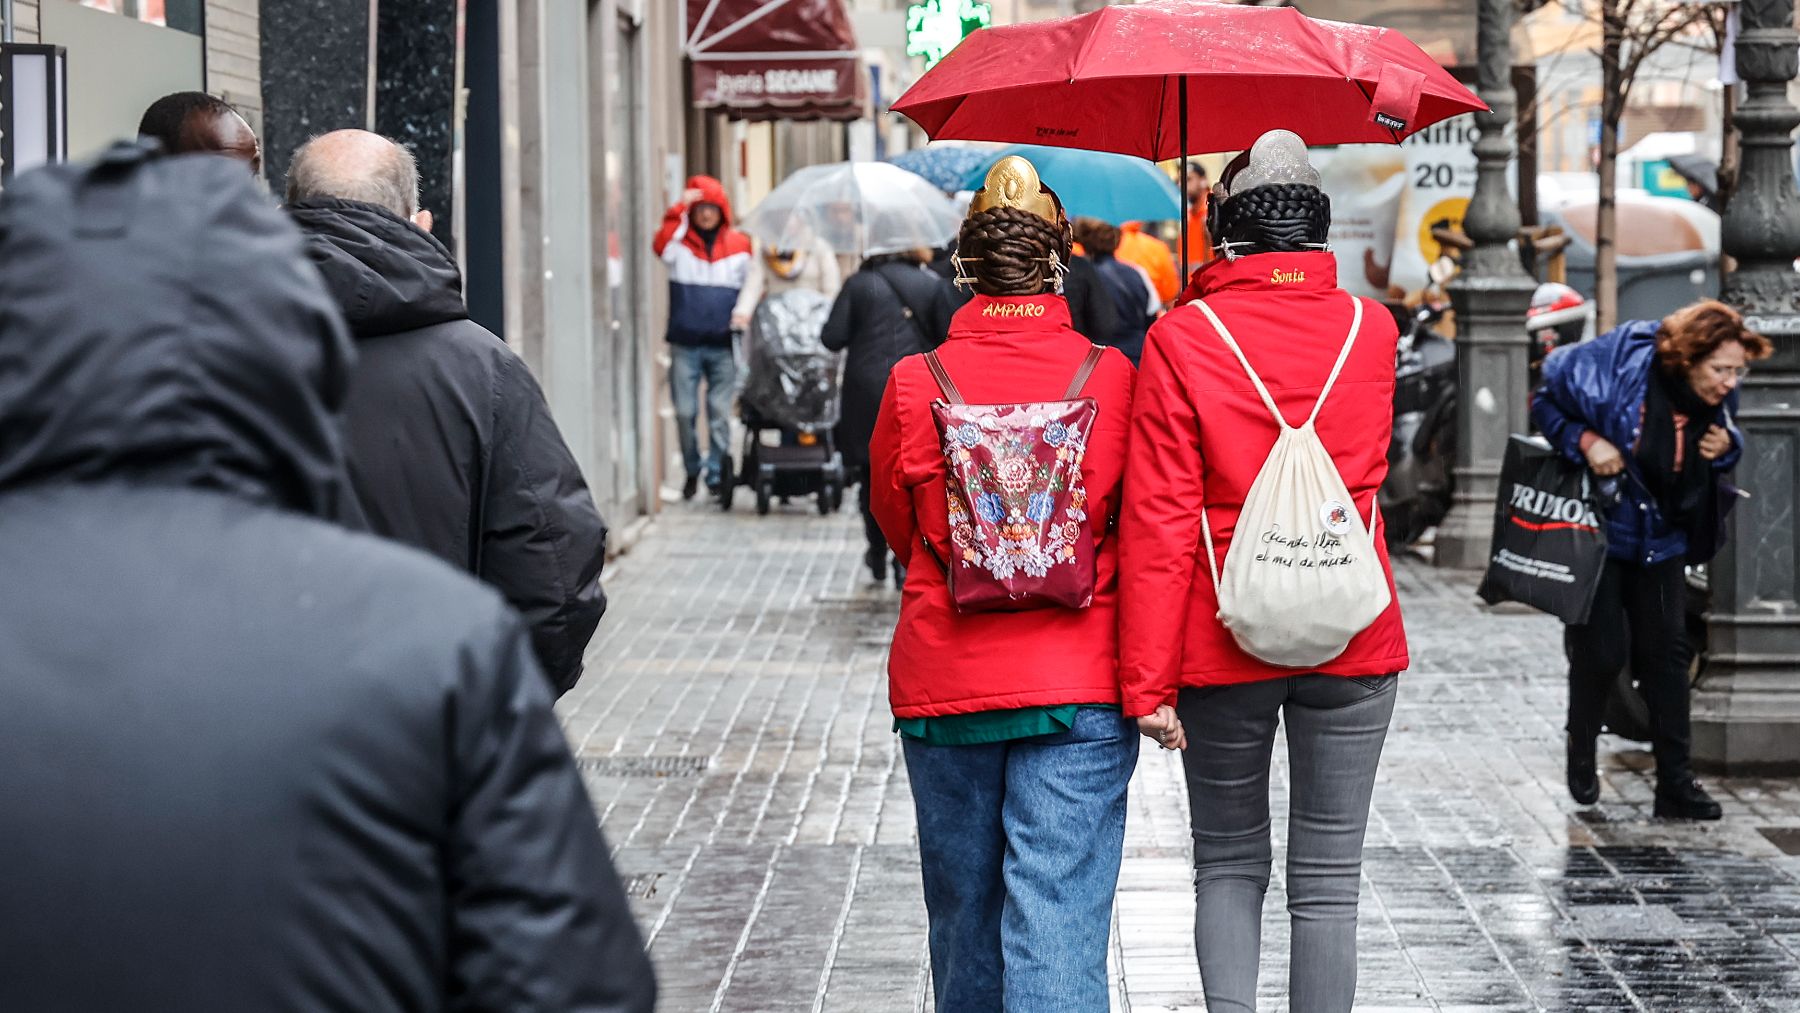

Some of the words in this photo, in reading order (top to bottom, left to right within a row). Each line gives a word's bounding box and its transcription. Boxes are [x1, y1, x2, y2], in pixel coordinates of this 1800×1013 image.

[1415, 163, 1453, 188] 20
[1270, 267, 1305, 284] Sonia
[982, 302, 1046, 318] AMPARO
